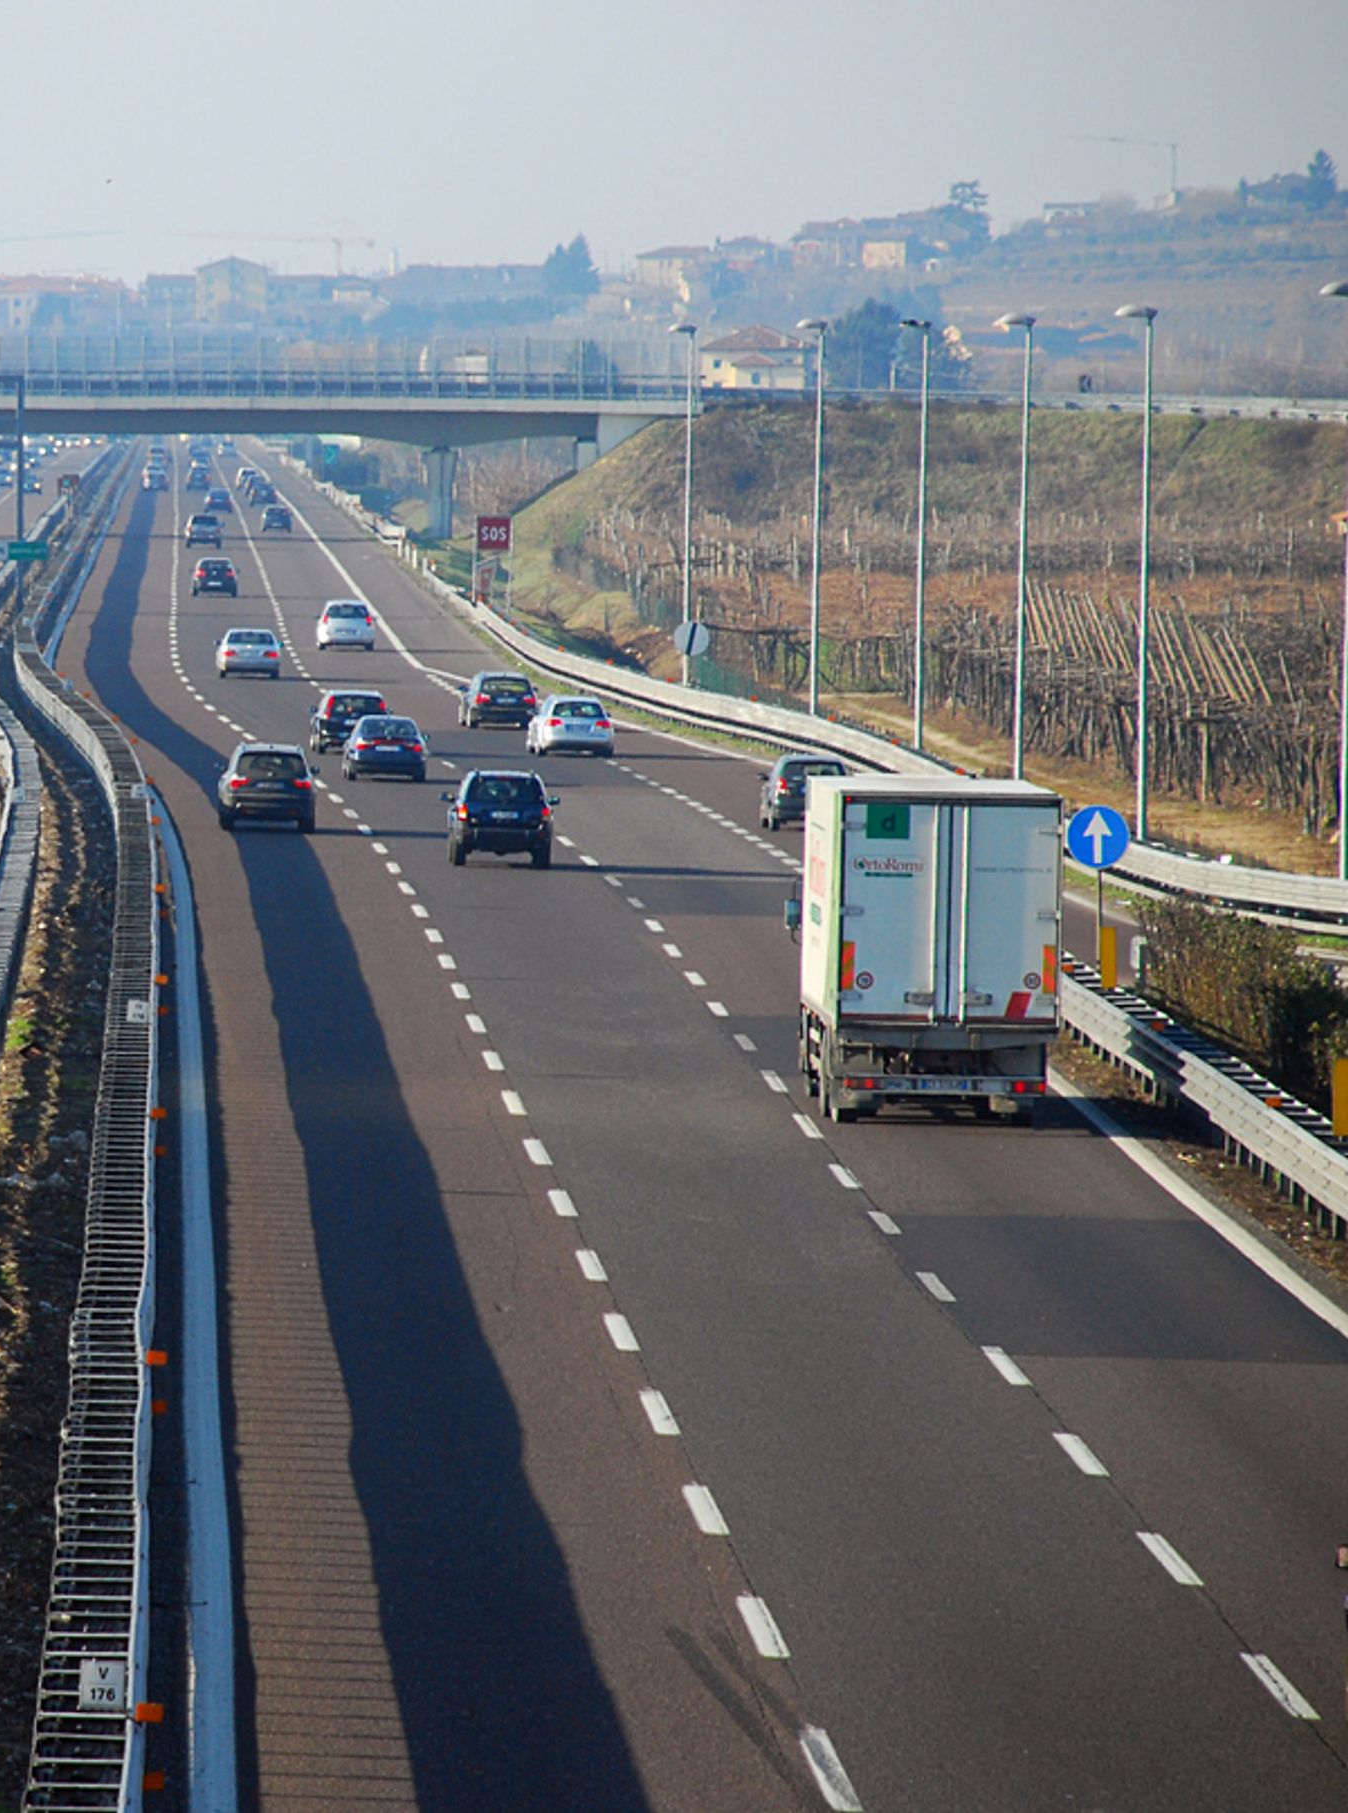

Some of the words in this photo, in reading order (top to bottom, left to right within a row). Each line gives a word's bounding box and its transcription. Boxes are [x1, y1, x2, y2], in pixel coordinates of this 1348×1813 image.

[480, 525, 507, 542] SOS
[881, 813, 896, 832] d
[98, 1666, 109, 1680] V
[90, 1687, 116, 1702] 176
